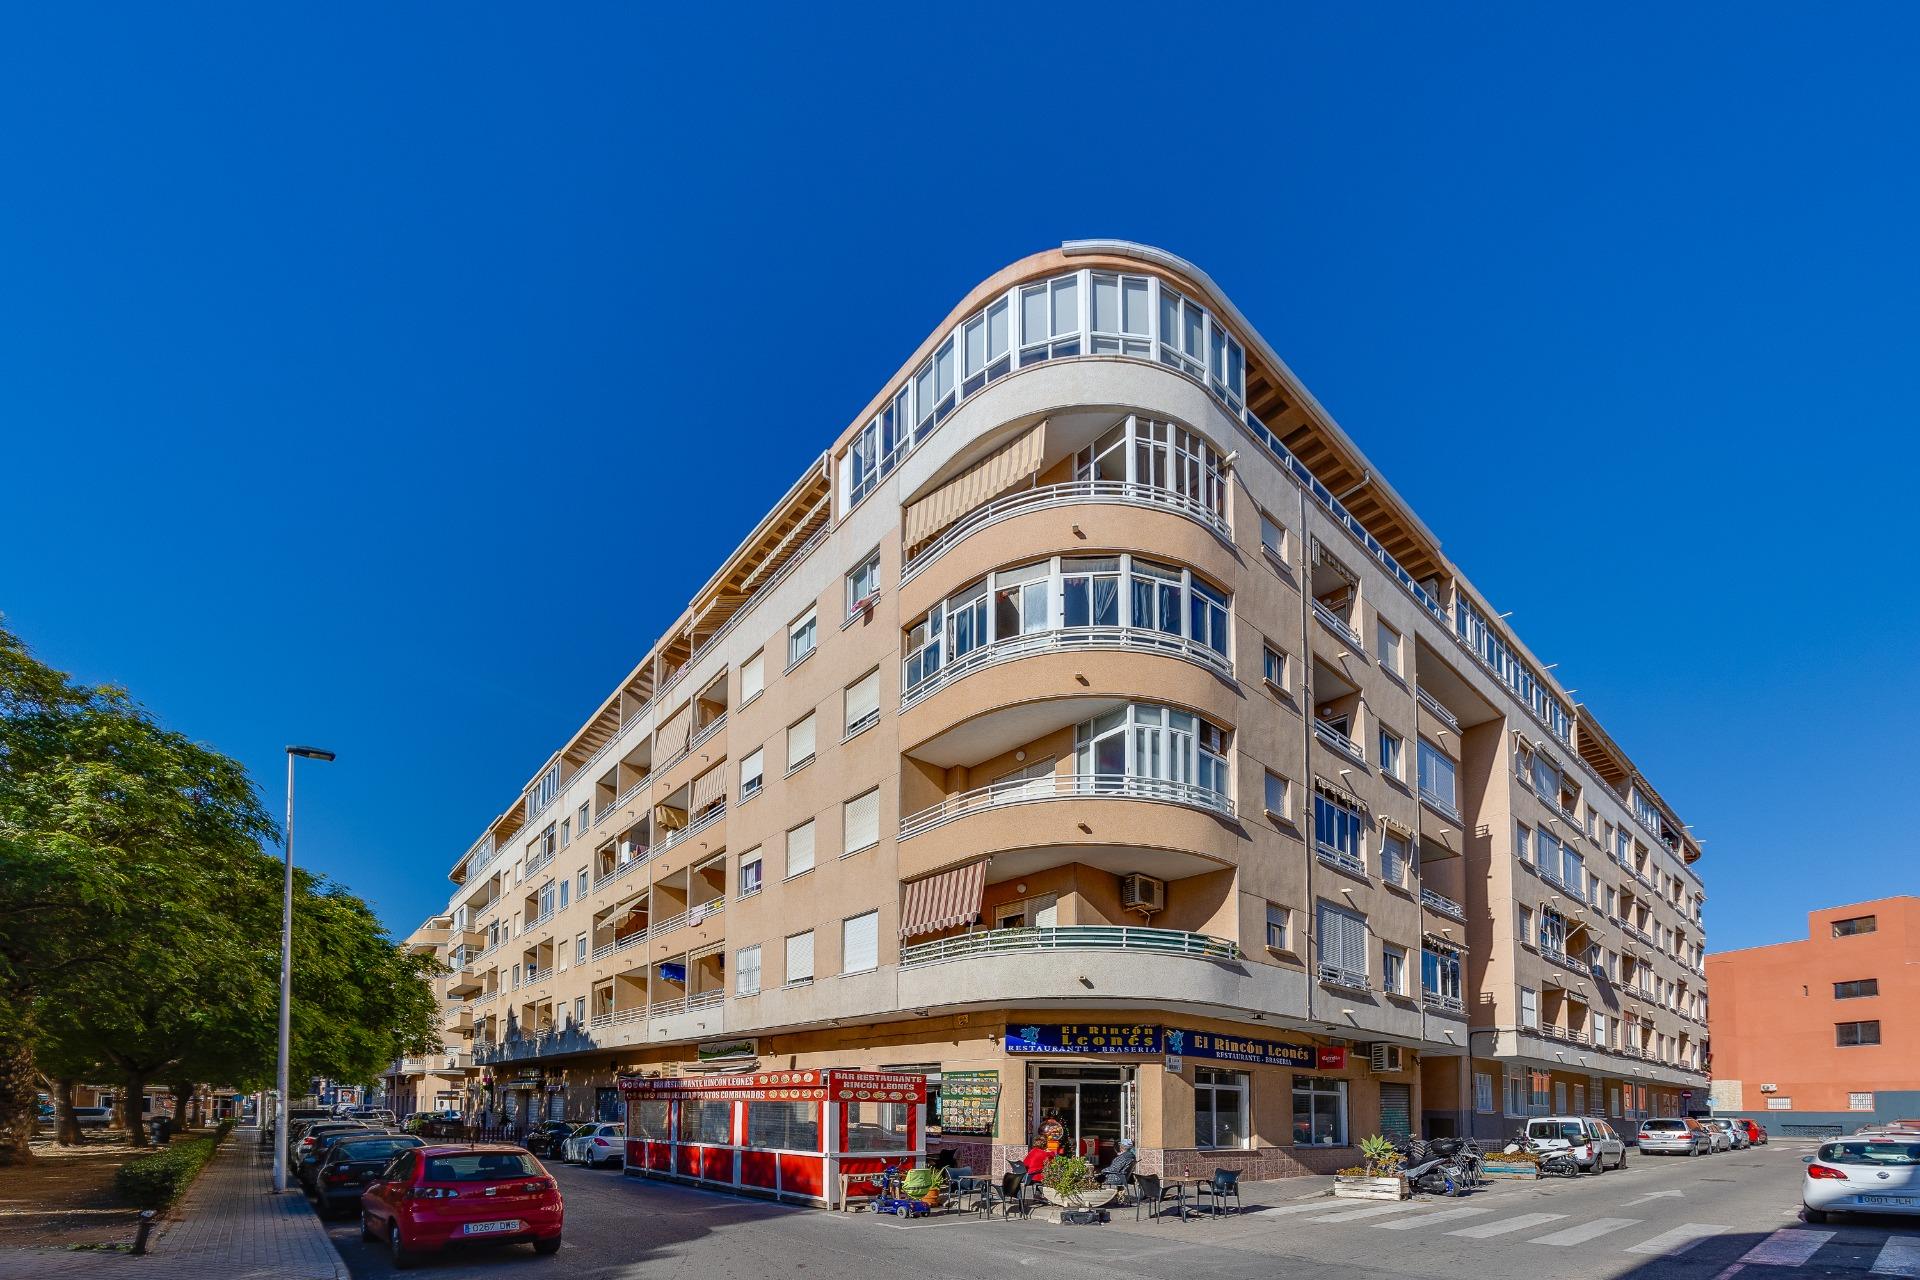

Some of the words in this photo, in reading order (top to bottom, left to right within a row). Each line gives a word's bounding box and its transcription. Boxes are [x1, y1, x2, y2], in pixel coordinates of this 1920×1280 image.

[1062, 1026, 1077, 1034] El
[1089, 1026, 1153, 1034] Rincón
[1062, 1035, 1153, 1046] Leonés
[1194, 1035, 1208, 1049] El
[1214, 1038, 1263, 1055] Rincón
[1268, 1044, 1309, 1061] Leonés
[1216, 1051, 1261, 1063] RESTAURANTE
[834, 1072, 855, 1080] BAR
[856, 1074, 922, 1083] RESTAURANTE
[843, 1080, 879, 1090] RINCÓN
[720, 1090, 766, 1099] COMBINADOS
